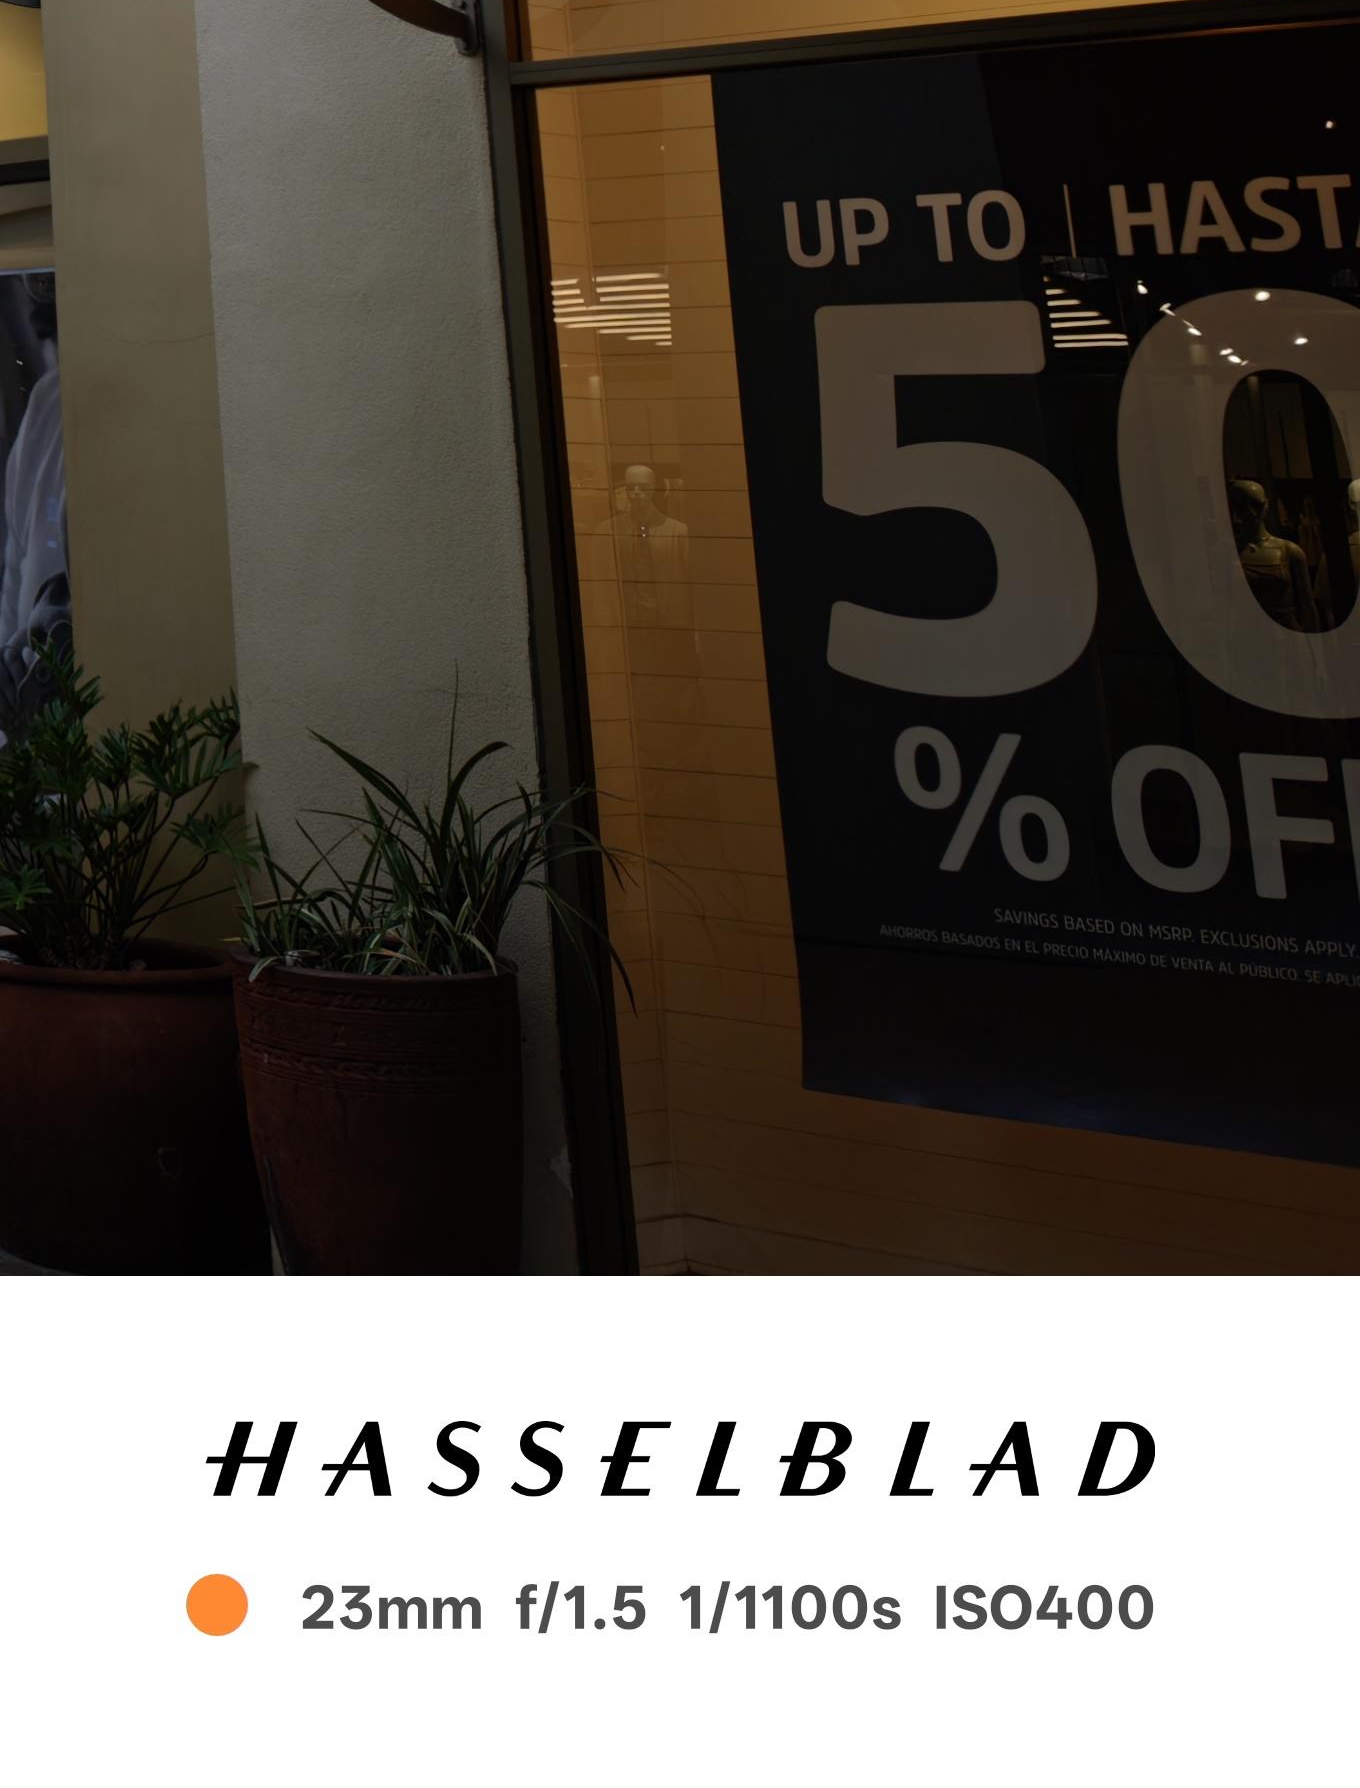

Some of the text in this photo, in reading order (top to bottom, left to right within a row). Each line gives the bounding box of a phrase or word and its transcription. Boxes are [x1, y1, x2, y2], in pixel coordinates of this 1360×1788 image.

[782, 172, 1360, 269] UP TO HAST
[814, 287, 1360, 720] 50
[893, 725, 1071, 883] %
[879, 923, 939, 943] AHORROS
[941, 930, 1001, 951] BASADOS
[1004, 937, 1022, 952] EN
[1024, 940, 1040, 955] EL
[1042, 941, 1089, 960] PRECIO
[1149, 954, 1168, 968] DE
[1170, 955, 1216, 974] VENTA
[1217, 960, 1235, 976] AL
[1303, 969, 1322, 984] SE
[993, 907, 1360, 960] SAVINGS BASED ON MSRP. EXCLUSIONS APPLY.
